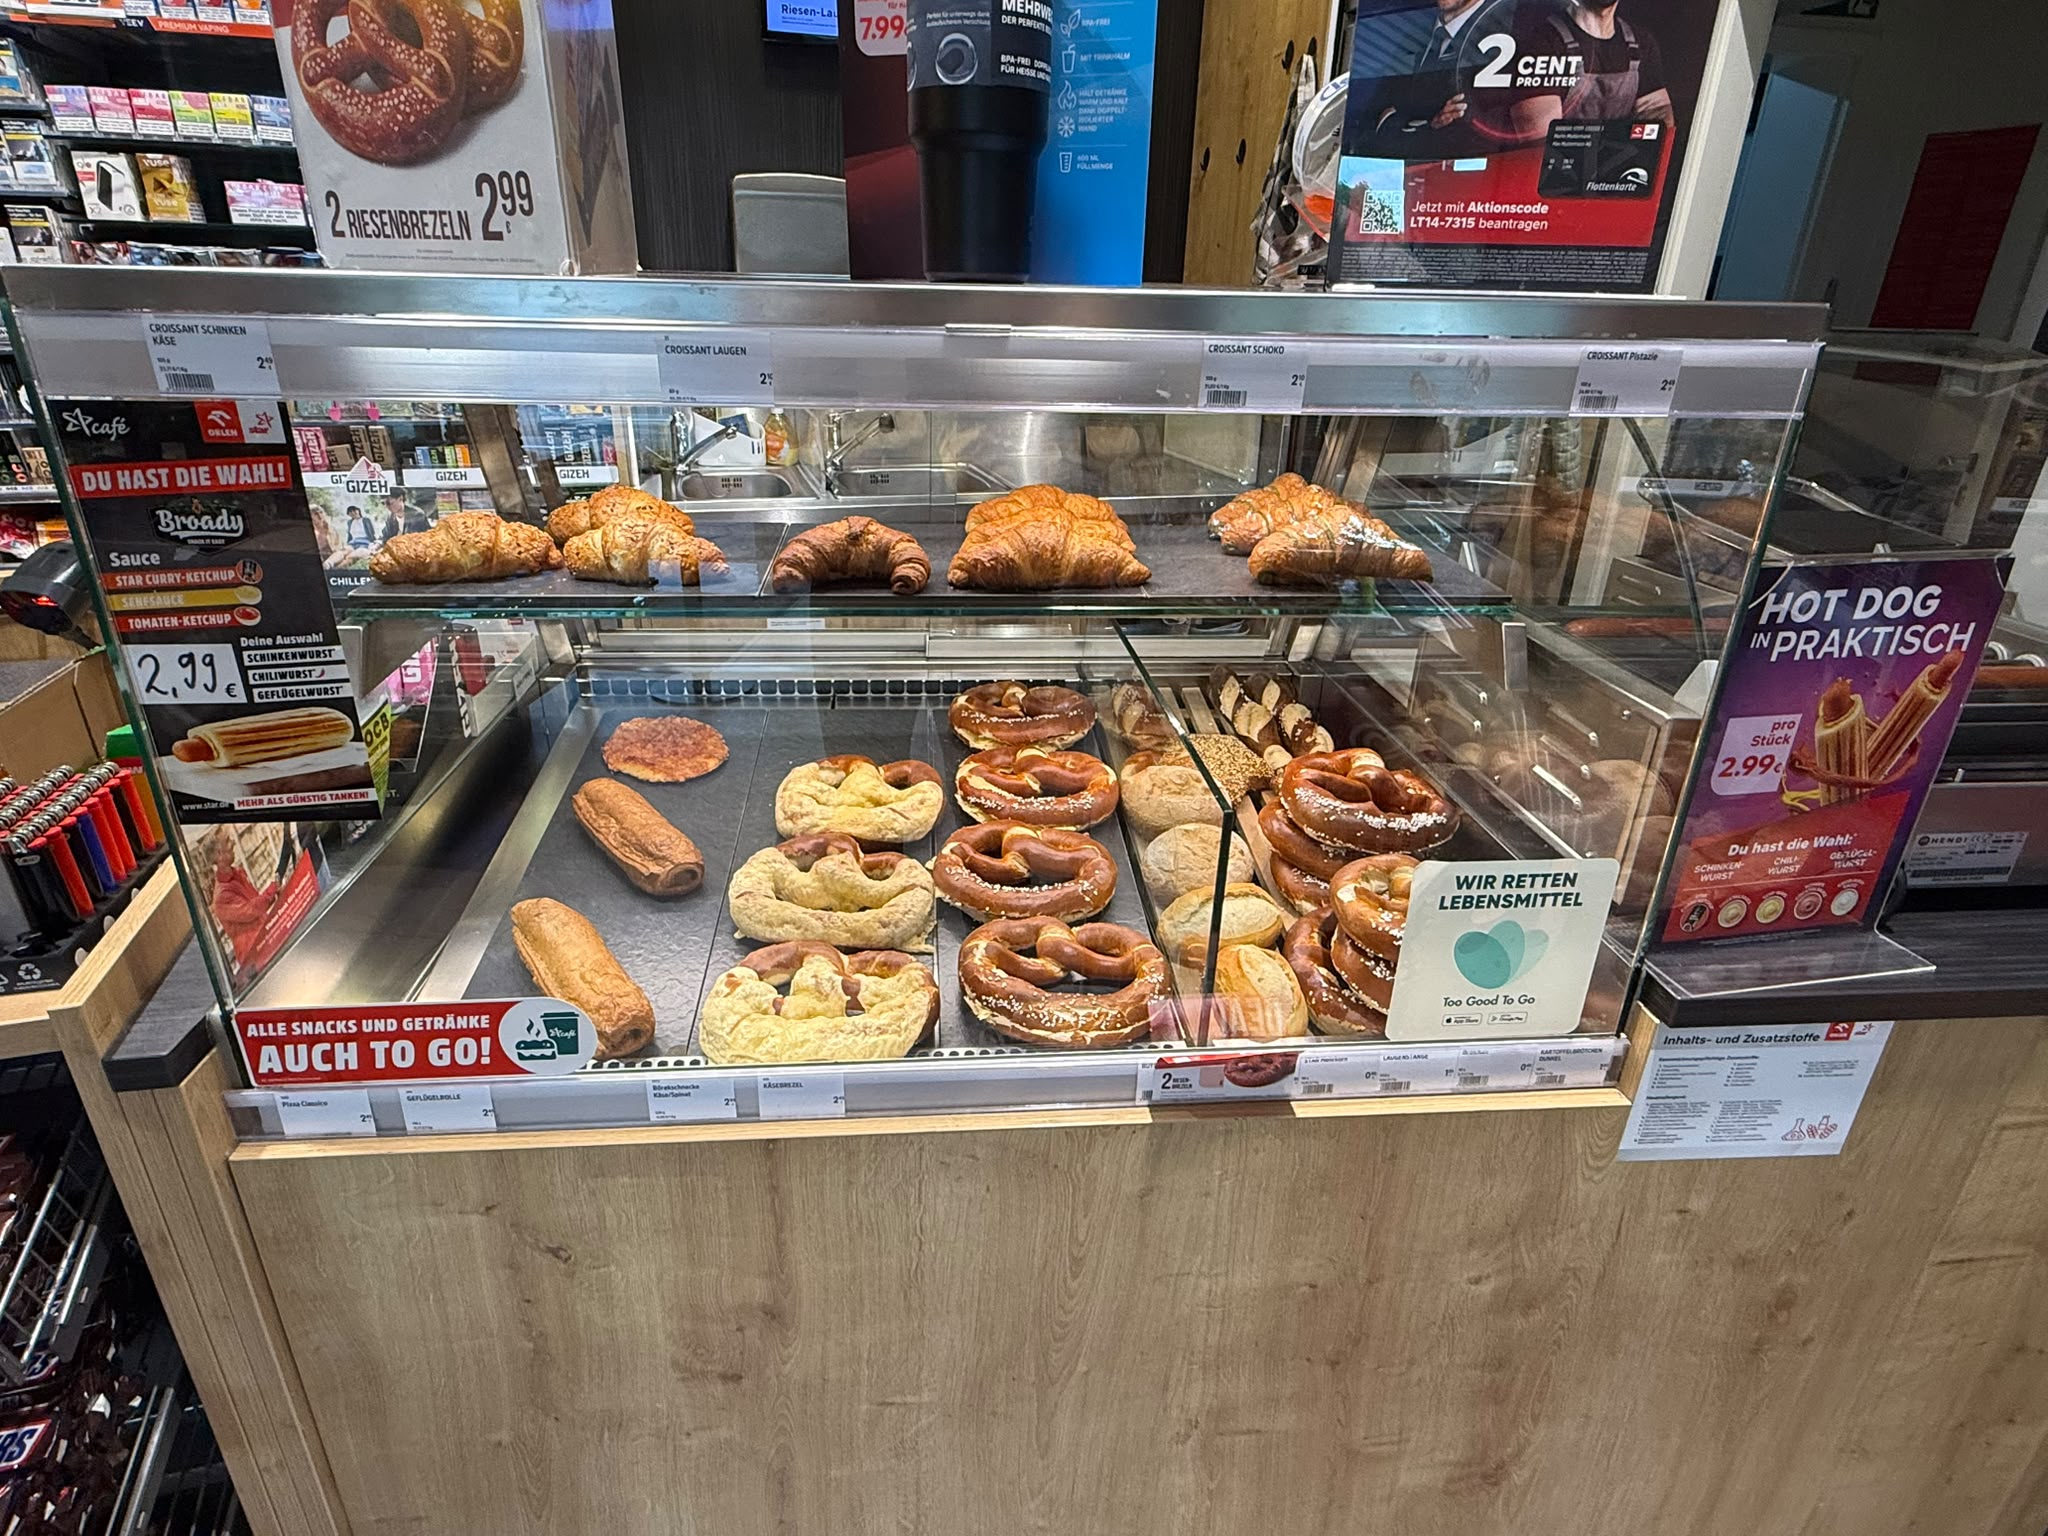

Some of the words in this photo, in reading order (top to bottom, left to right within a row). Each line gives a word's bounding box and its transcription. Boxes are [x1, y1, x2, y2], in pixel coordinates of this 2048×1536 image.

[158, 21, 197, 32] PREMIUM
[199, 23, 230, 34] VAPING
[1001, 15, 1017, 25] DER
[1001, 54, 1031, 66] BPA-FREI
[1473, 33, 1517, 88] 2
[1518, 55, 1583, 75] CENT
[1001, 64, 1015, 74] FÜR
[1516, 76, 1541, 88] PRO
[1586, 181, 1637, 192] Flottenkarte
[1411, 201, 1442, 214] Jetzt
[1445, 201, 1465, 213] mit
[1467, 201, 1549, 214] Aktionscode
[325, 190, 346, 238] 2
[346, 208, 471, 241] RIESENBREZELN
[1410, 216, 1475, 228] LT14-7315
[1478, 217, 1548, 230] beantragen
[149, 323, 199, 334] CROISSANT
[201, 325, 247, 336] SCHINKEN
[152, 335, 177, 346] KÄSE
[665, 345, 711, 355] CROISSANT
[713, 346, 747, 356] LAUGEN
[1208, 344, 1251, 354] CROISSANT
[1253, 345, 1285, 354] SCHOKO
[1587, 351, 1628, 360] CROISSANT
[1629, 352, 1658, 361] Pistazie
[92, 416, 130, 441] café
[305, 430, 323, 465] GIZEH
[370, 430, 384, 463] GIZEH
[561, 431, 574, 462] GIZEH
[81, 471, 112, 492] DU
[117, 467, 169, 490] HAST
[174, 465, 212, 487] DIE
[215, 463, 285, 485] WAHL!
[436, 471, 468, 481] GIZEH
[559, 469, 590, 479] GIZEH
[346, 480, 388, 493] GIZEH
[155, 509, 244, 537] Broady
[109, 552, 160, 567] Sauce
[116, 574, 143, 586] STAR
[146, 570, 235, 585] CURRY-KETCHUP
[1758, 588, 1848, 625] HOT
[1852, 585, 1943, 620] DOG
[128, 613, 232, 630] TOMATEN-KETCHUP
[240, 636, 273, 648] Deine
[275, 633, 323, 645] Auswahl
[1750, 632, 1772, 649] IN
[1770, 622, 1976, 662] PRAKTISCH
[137, 652, 217, 698] 2,99
[224, 683, 237, 698] €
[364, 711, 389, 748] OCB
[1771, 720, 1796, 733] pro
[1750, 732, 1790, 747] Stück
[237, 798, 264, 808] MEHR
[266, 797, 284, 806] ALS
[286, 793, 327, 805] GÜNSTIG
[329, 791, 369, 801] TANKEN!
[1728, 843, 1748, 856] Du
[1751, 841, 1783, 854] hast
[1786, 838, 1809, 850] die
[1694, 860, 1744, 874] SCHINKEN-
[1768, 864, 1800, 875] WURST
[1455, 874, 1496, 890] WIR
[1501, 872, 1578, 889] RETTEN
[1700, 871, 1734, 882] WURST
[1438, 892, 1583, 911] LEBENSMITTEL
[1443, 997, 1462, 1007] Too
[1466, 994, 1499, 1006] Good
[1502, 995, 1514, 1005] To
[1518, 994, 1535, 1005] Go
[247, 1023, 287, 1037] ALLE
[291, 1019, 358, 1035] SNACKS
[362, 1017, 397, 1032] UND
[402, 1014, 490, 1031] GETRÄNKE
[1664, 1035, 1711, 1046] Inhalts-
[1715, 1034, 1740, 1045] und
[1743, 1032, 1820, 1044] Zusatzstoffe
[258, 1042, 358, 1073] AUCH
[370, 1039, 414, 1069] TO
[428, 1037, 491, 1067] GO!
[763, 1081, 803, 1089] KÄSEBREZEL
[1161, 1072, 1172, 1089] 2
[406, 1093, 461, 1102] GEFLÜGELROLLE
